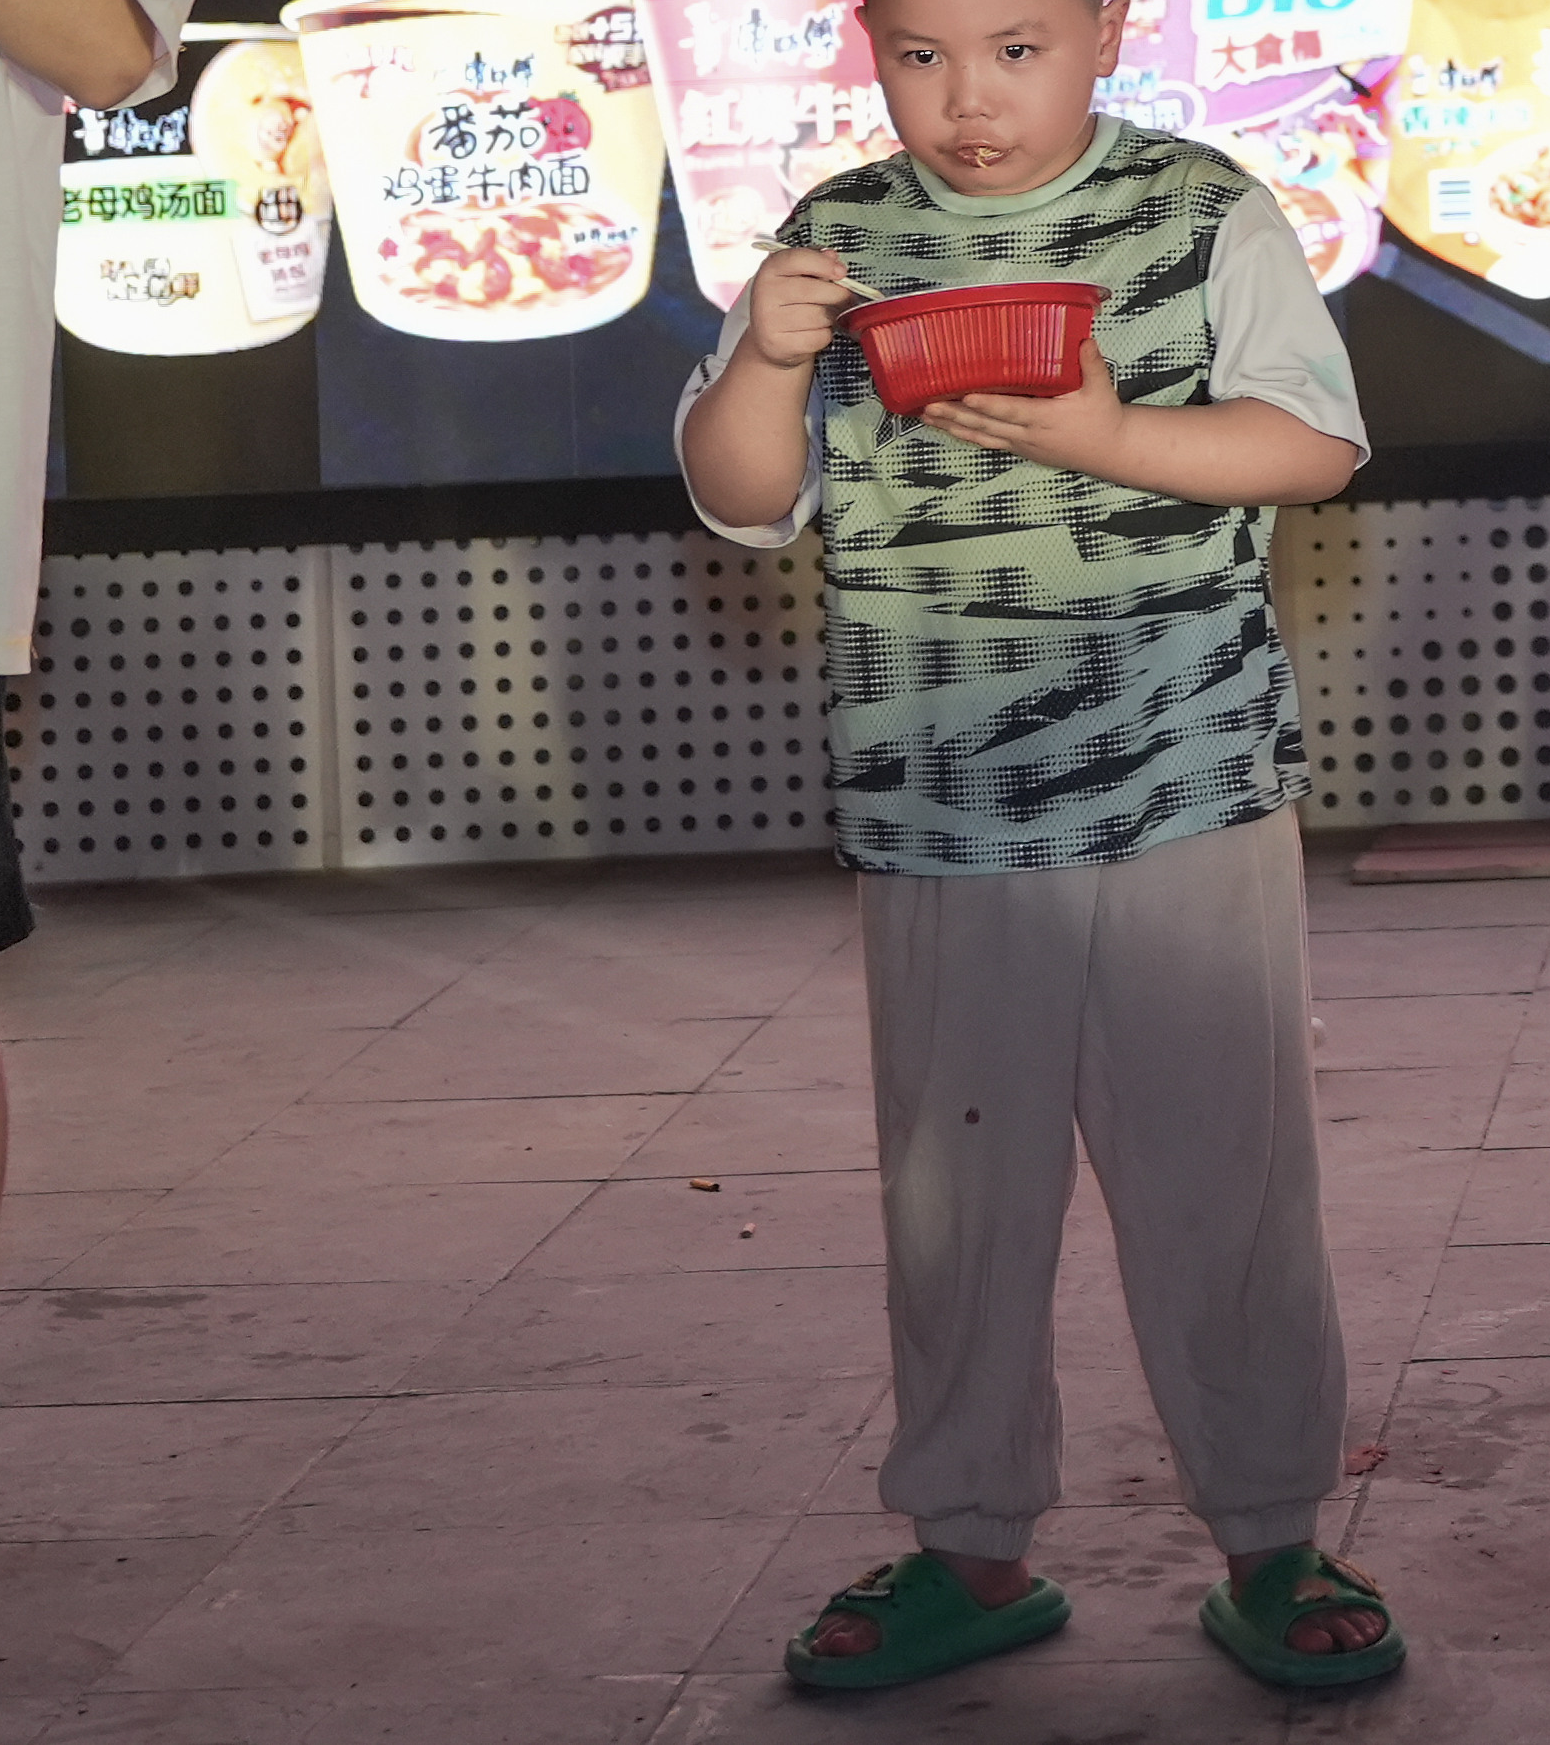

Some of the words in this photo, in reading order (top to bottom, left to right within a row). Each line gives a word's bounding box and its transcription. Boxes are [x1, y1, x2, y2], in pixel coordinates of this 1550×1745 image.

[428, 102, 541, 160] 番茄
[62, 181, 227, 223] 老母鸡汤面
[382, 154, 590, 206] 鸡蛋牛肉面
